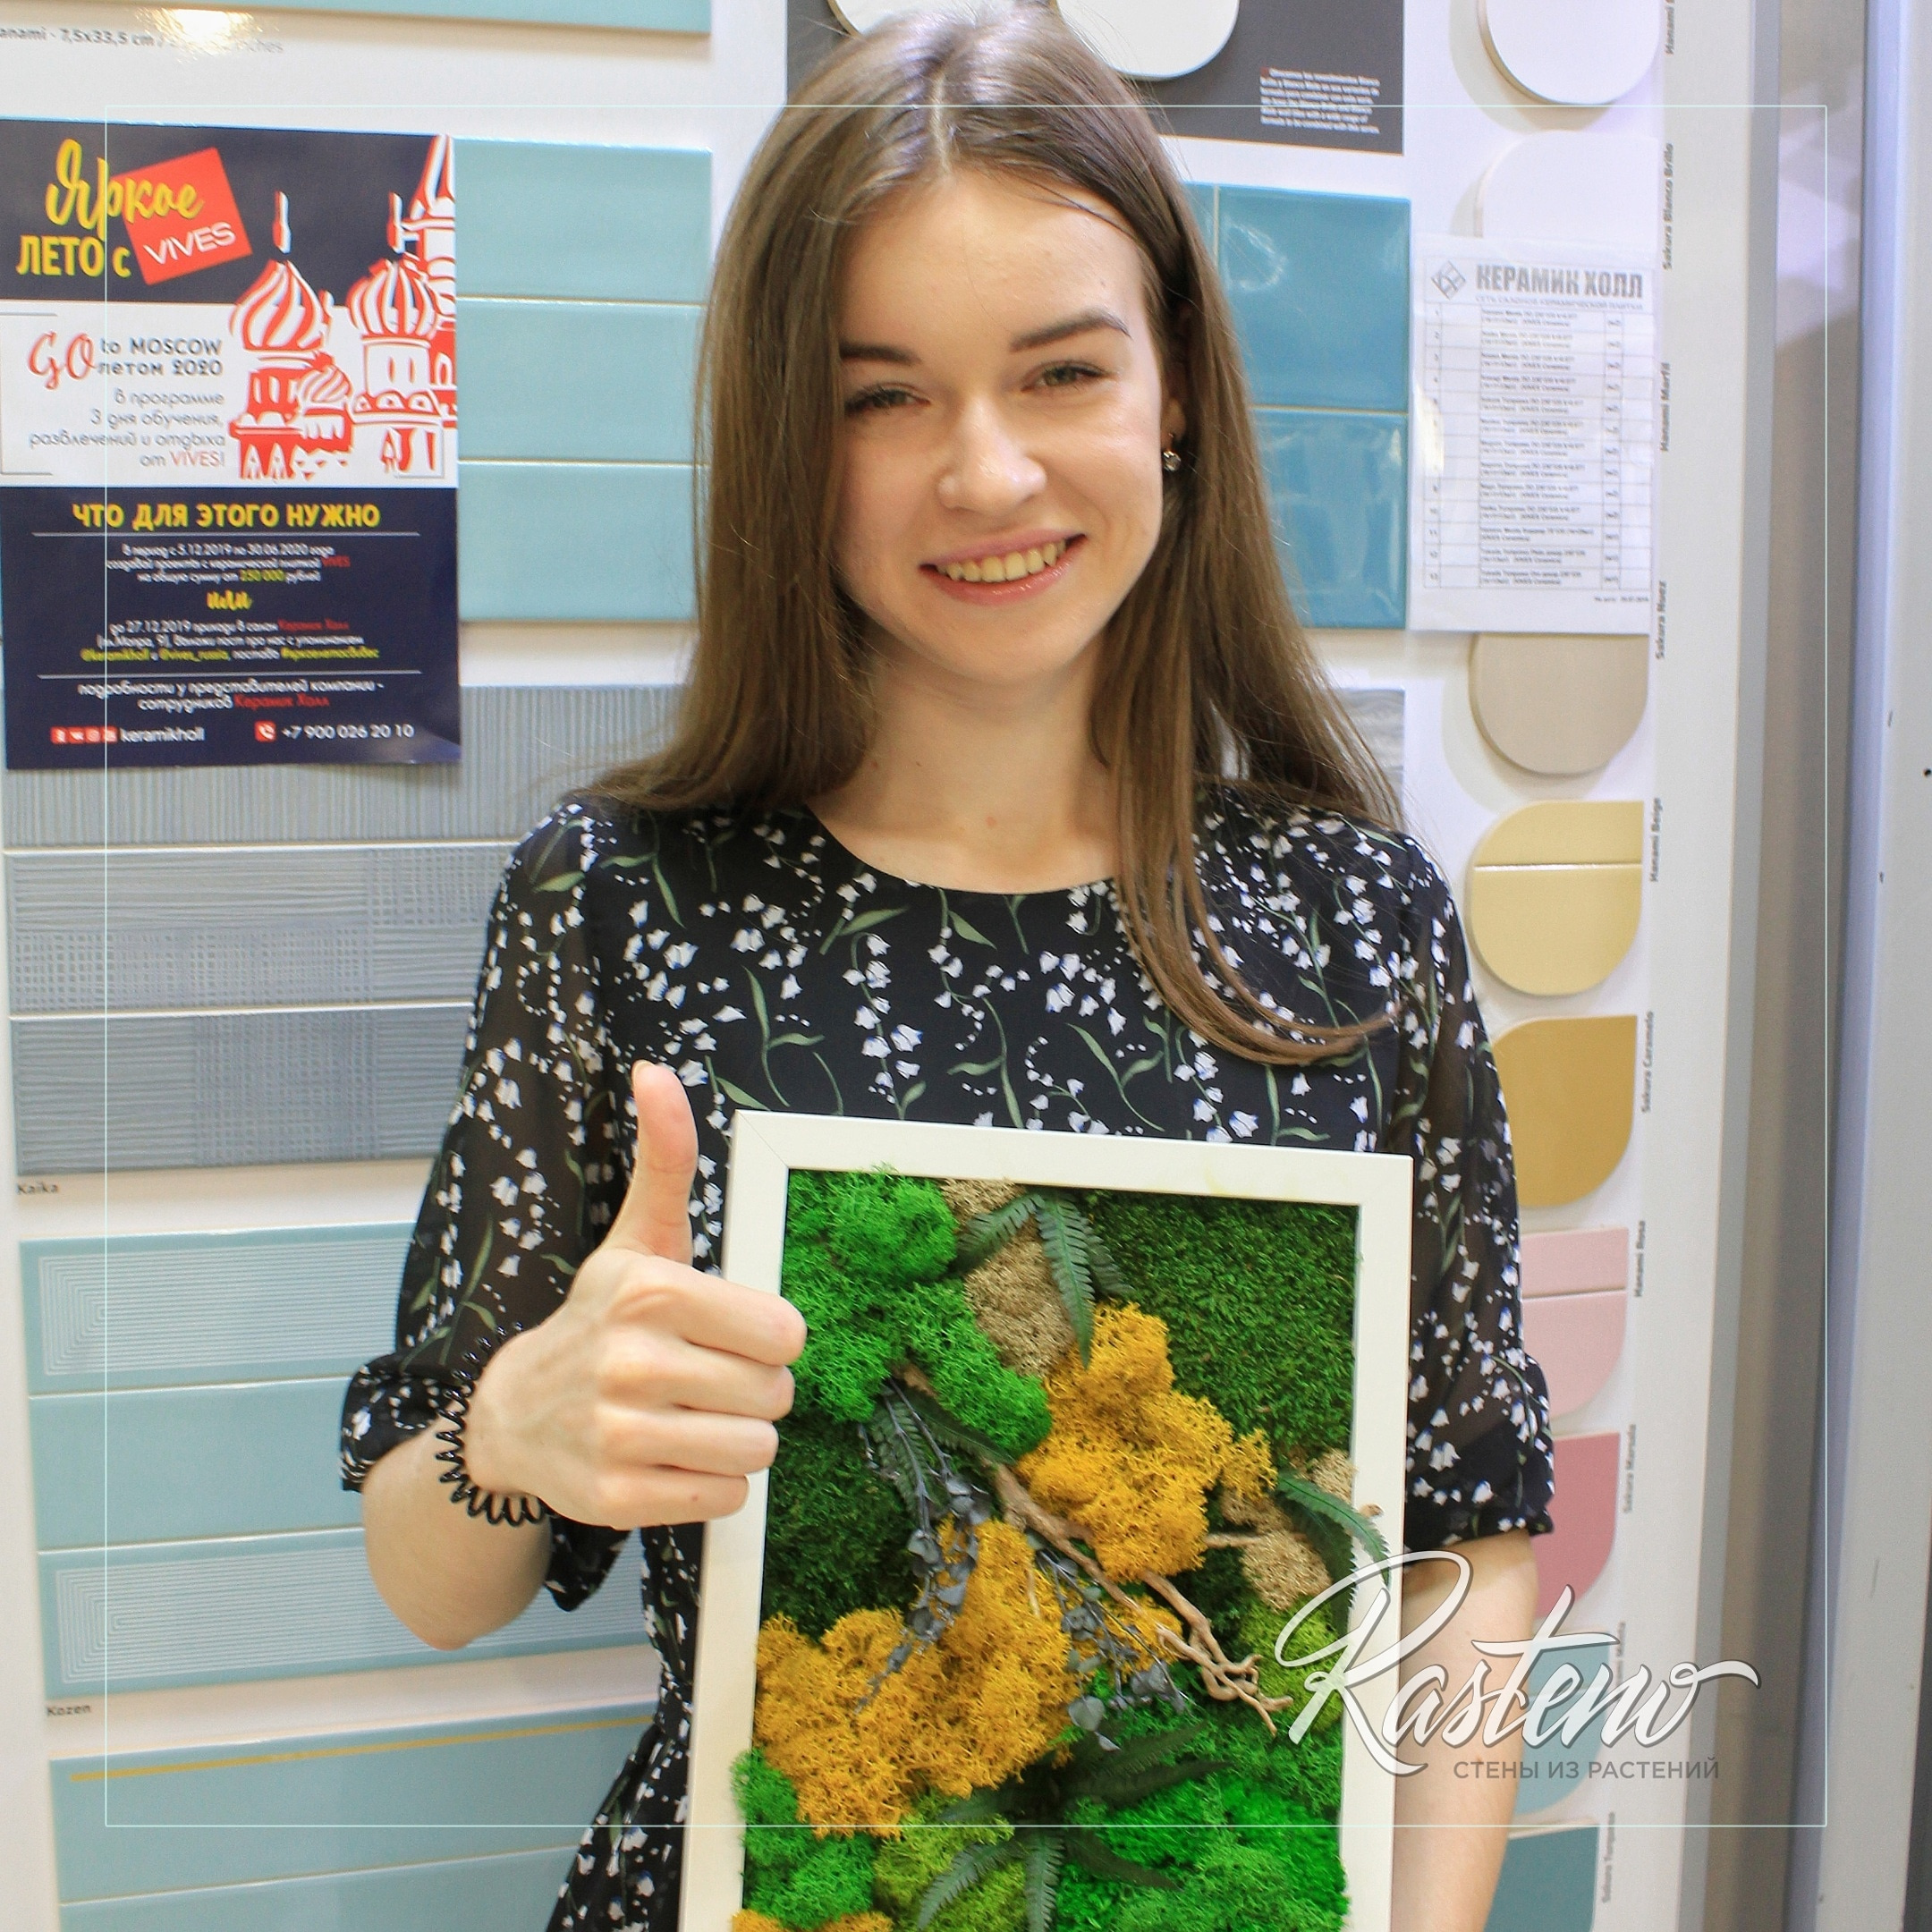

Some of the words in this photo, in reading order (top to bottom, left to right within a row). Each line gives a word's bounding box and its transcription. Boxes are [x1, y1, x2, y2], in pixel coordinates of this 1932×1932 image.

[46, 139, 205, 240] Яркое
[143, 221, 236, 265] VIVES
[1661, 225, 1674, 271] Sakura
[17, 234, 105, 275] ЛЕТО
[1475, 265, 1580, 296] КЕРАМИК
[1584, 271, 1643, 299] ХОЛЛ
[29, 329, 97, 390] GO
[99, 337, 122, 355] to
[130, 337, 223, 356] MOSCOW
[97, 360, 164, 376] летом
[173, 359, 224, 376] 2020
[131, 394, 225, 409] программе
[90, 408, 102, 425] 3
[107, 414, 137, 430] дня
[30, 430, 138, 448] развлечений
[155, 434, 225, 450] отдыха
[140, 454, 166, 468] от
[72, 503, 124, 528] ЧТО
[132, 504, 188, 531] ДЛЯ
[196, 503, 279, 528] ЭТОГО
[286, 504, 381, 529] НУЖНО
[1655, 615, 1666, 660] Sakura
[78, 681, 174, 699] подробности
[120, 726, 205, 742] keramikholl
[282, 725, 301, 740] +7
[304, 724, 334, 740] 900
[336, 724, 368, 739] 026
[370, 724, 392, 739] 20
[394, 724, 414, 738] 10
[16, 1182, 60, 1195] Kaika
[47, 1705, 91, 1716] Kozen
